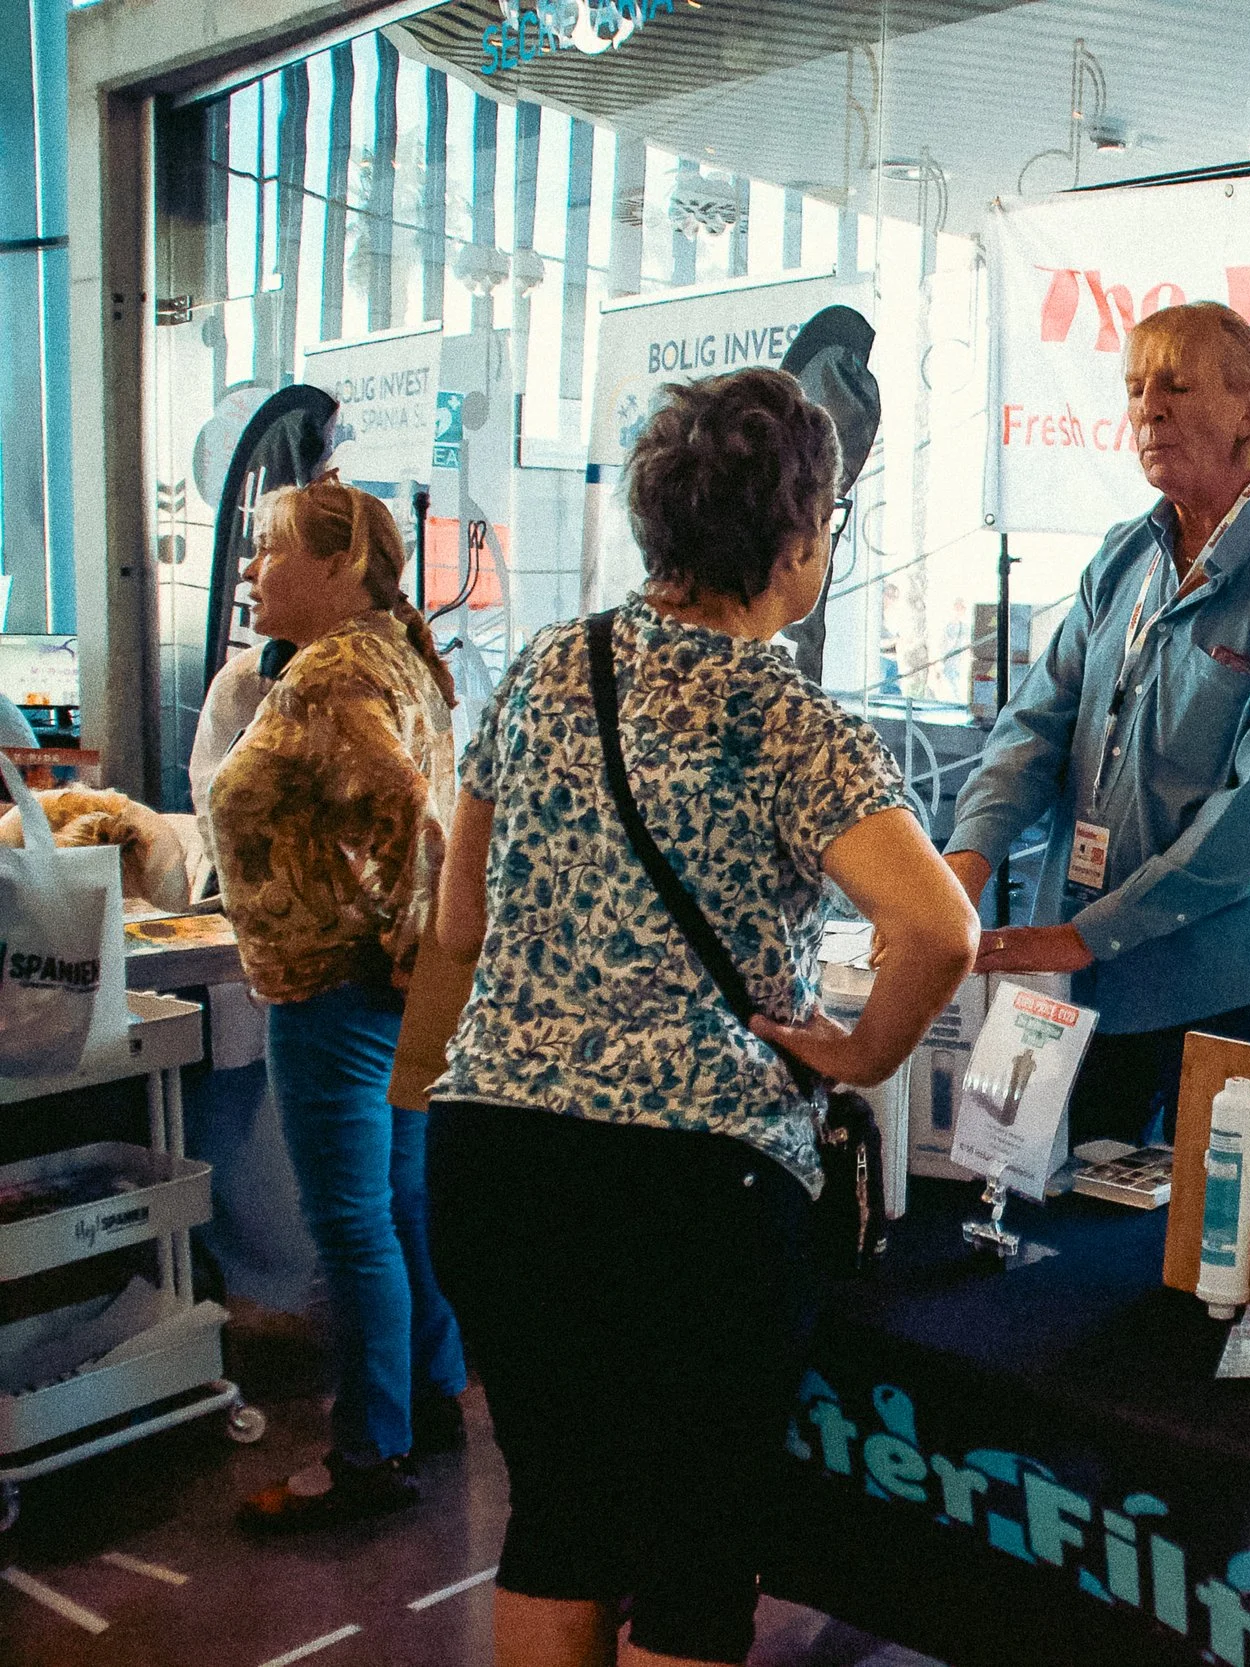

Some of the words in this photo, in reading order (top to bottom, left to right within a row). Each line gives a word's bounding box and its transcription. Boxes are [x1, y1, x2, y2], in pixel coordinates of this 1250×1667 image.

[648, 334, 716, 374] BOLIG
[724, 321, 801, 365] INVES
[380, 367, 430, 399] INVEST
[1002, 402, 1085, 447] Fresh
[434, 448, 460, 467] EA
